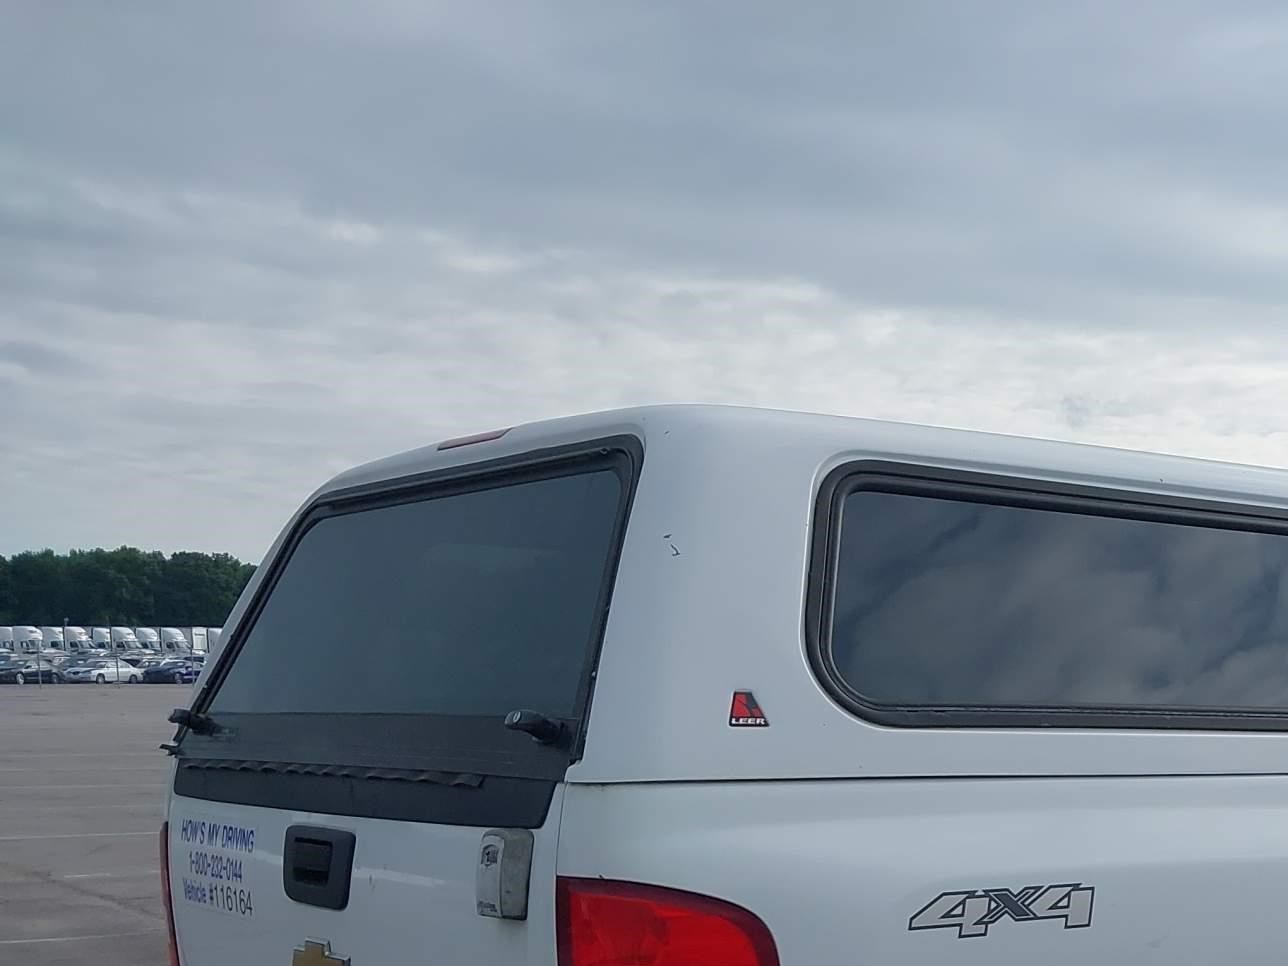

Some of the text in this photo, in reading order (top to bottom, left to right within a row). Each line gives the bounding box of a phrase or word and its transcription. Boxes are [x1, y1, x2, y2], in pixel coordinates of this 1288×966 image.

[731, 717, 766, 725] LEER
[207, 823, 220, 847] MY
[221, 825, 255, 853] DRIVING
[189, 851, 243, 884] 1-800-232-0144
[183, 878, 253, 916] Vehicle #116164
